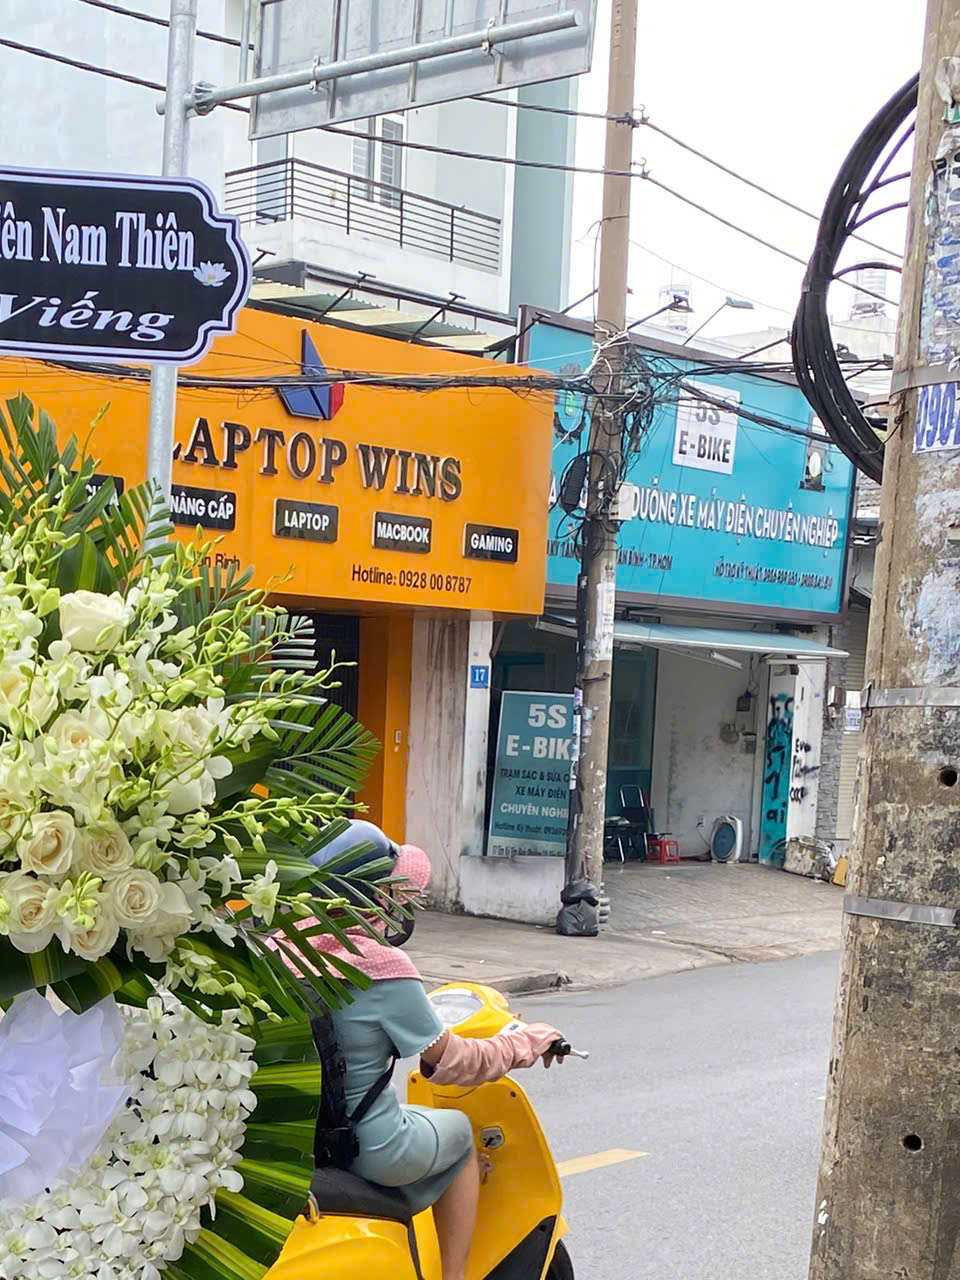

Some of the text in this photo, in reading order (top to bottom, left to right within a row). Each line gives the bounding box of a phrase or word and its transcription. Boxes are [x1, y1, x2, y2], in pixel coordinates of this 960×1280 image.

[40, 206, 107, 267] Nam
[115, 211, 196, 271] Thiên
[173, 417, 462, 502] APTOP WINS
[171, 491, 234, 519] NÂNG CẤP
[678, 492, 696, 526] XE
[697, 487, 725, 531] MÁY
[755, 498, 800, 543] CHUYÊN
[284, 509, 330, 532] LAPTOP
[377, 521, 429, 544] MACBOOK
[470, 533, 513, 554] GAMING
[352, 563, 472, 593] Hotline: 0928 00 8787
[474, 669, 485, 682] 17
[528, 703, 567, 729] 5S
[505, 735, 570, 761] E-BIK
[515, 785, 526, 795] XE
[500, 802, 539, 816] CHUYÊN
